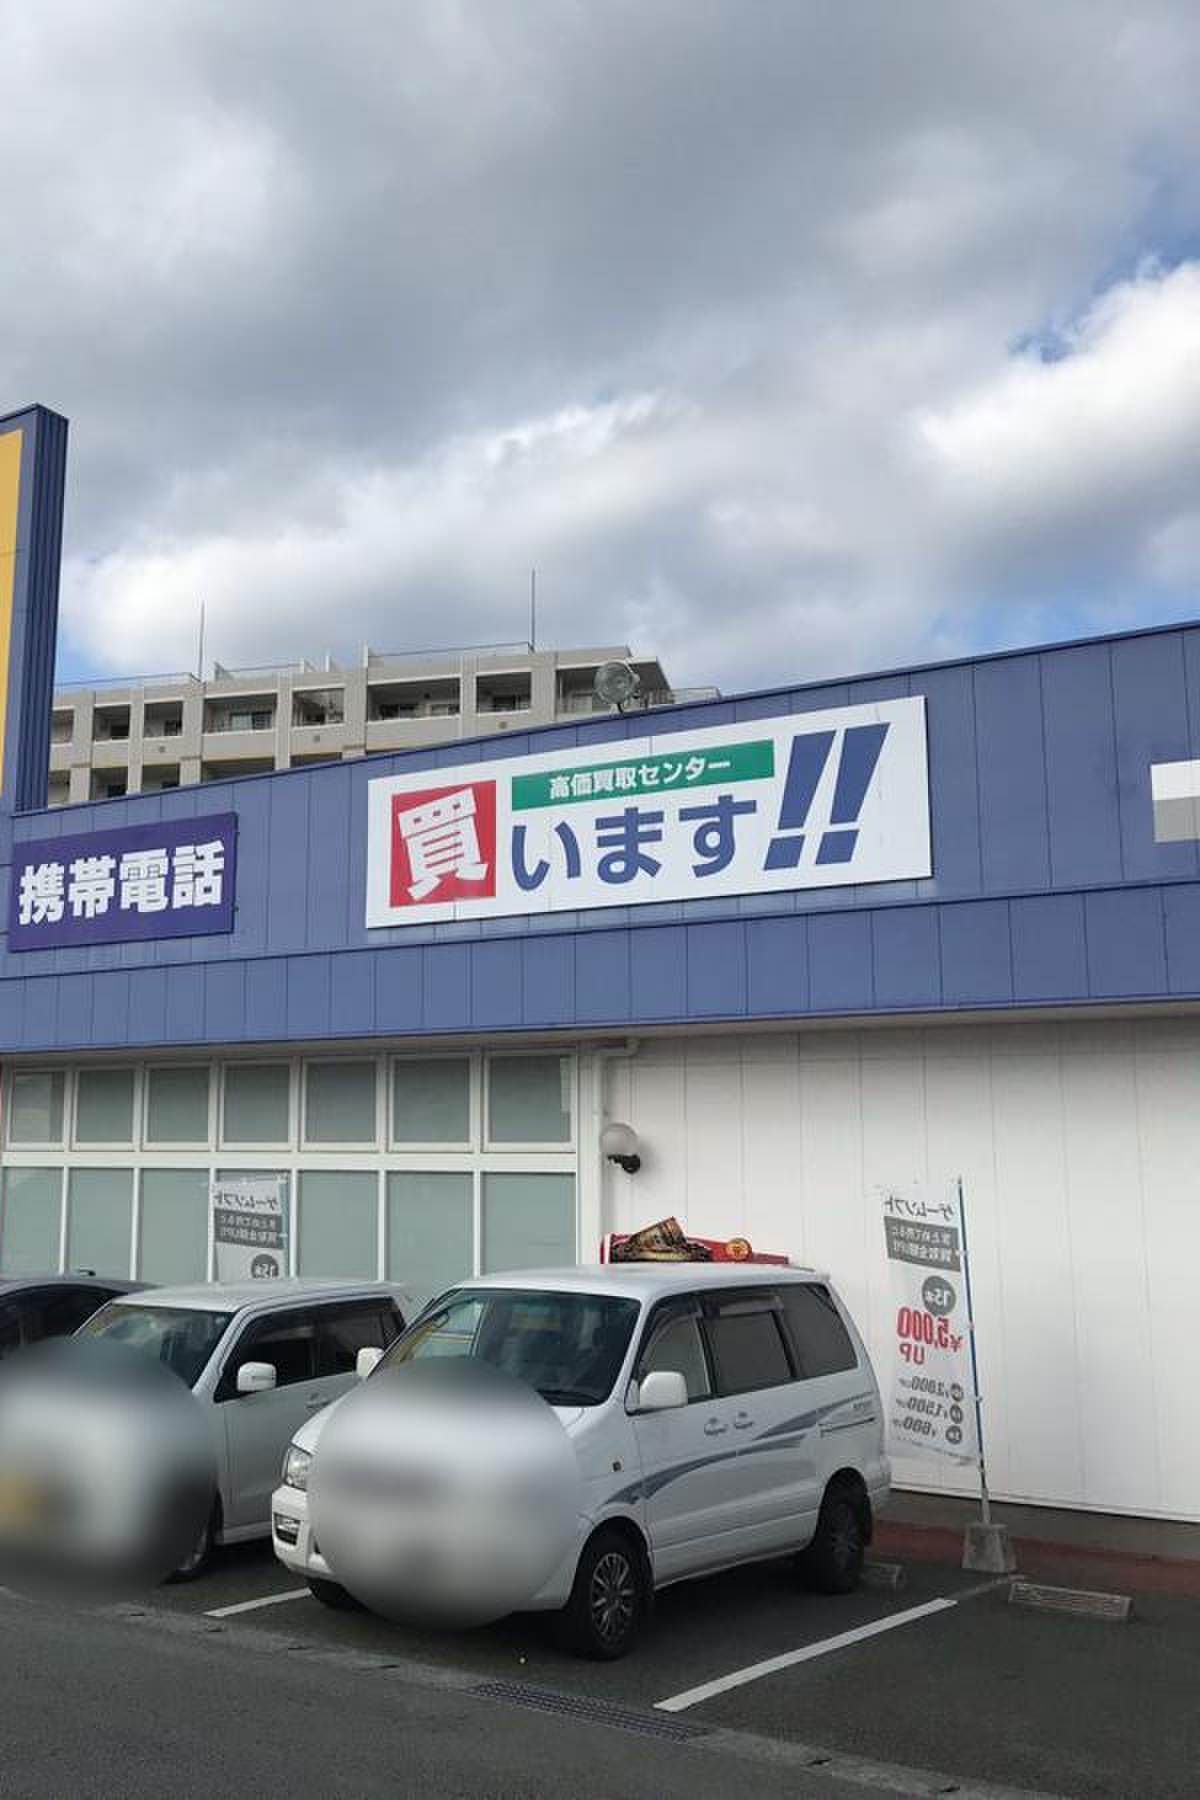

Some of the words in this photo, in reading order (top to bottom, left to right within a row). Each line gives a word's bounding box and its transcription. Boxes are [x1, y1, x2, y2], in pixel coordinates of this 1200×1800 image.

[548, 757, 731, 800] 高価買取センター
[18, 840, 225, 926] 携帯電話
